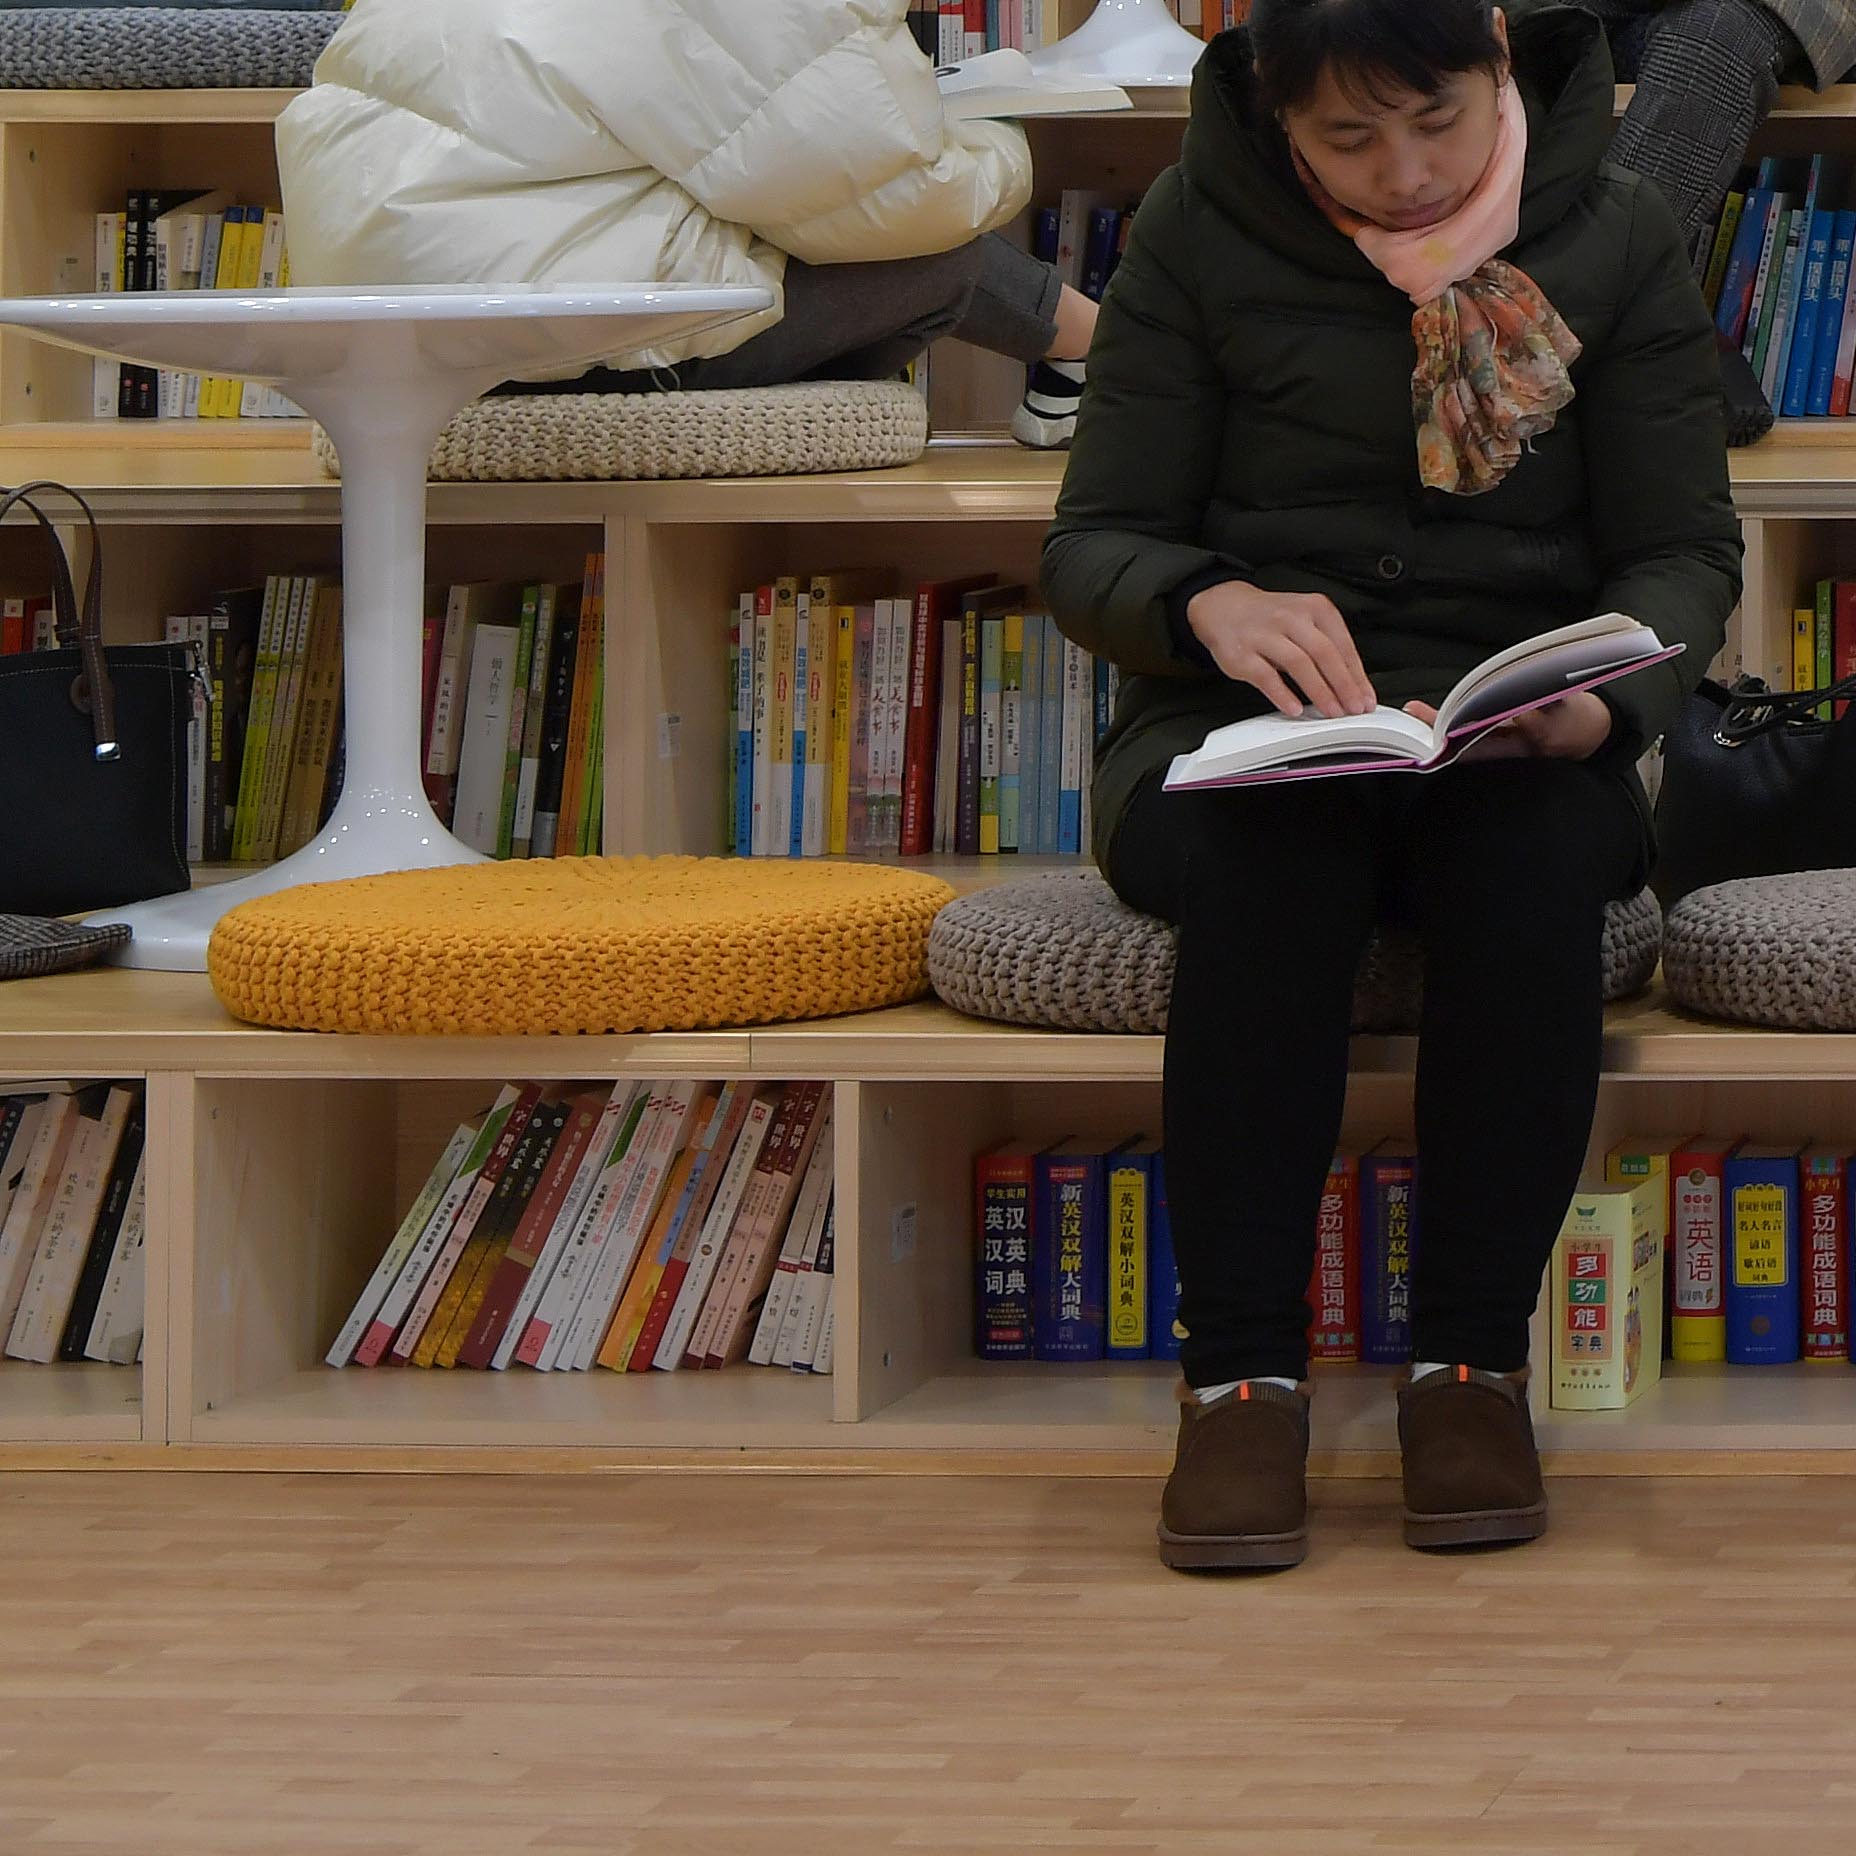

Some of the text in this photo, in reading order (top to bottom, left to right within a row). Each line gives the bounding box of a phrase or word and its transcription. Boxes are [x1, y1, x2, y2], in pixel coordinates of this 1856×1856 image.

[984, 1204, 1028, 1231] 英汉
[1738, 1218, 1783, 1232] 名人名言
[983, 1236, 1028, 1264] 汉英
[1059, 1183, 1083, 1322] 新英汉双解大词典
[1119, 1191, 1137, 1309] 英汉双解小词典
[1319, 1193, 1347, 1326] 多功能成语词典
[1387, 1183, 1410, 1323] 新英汉双解大词典
[1687, 1217, 1714, 1283] 英语
[1743, 1255, 1778, 1270] 歇后语
[1748, 1239, 1772, 1252] 谚语
[1811, 1194, 1839, 1327] 多功能成语词典
[983, 1269, 1028, 1297] 词典
[1573, 1255, 1602, 1329] 多功能
[1570, 1334, 1603, 1352] 字典
